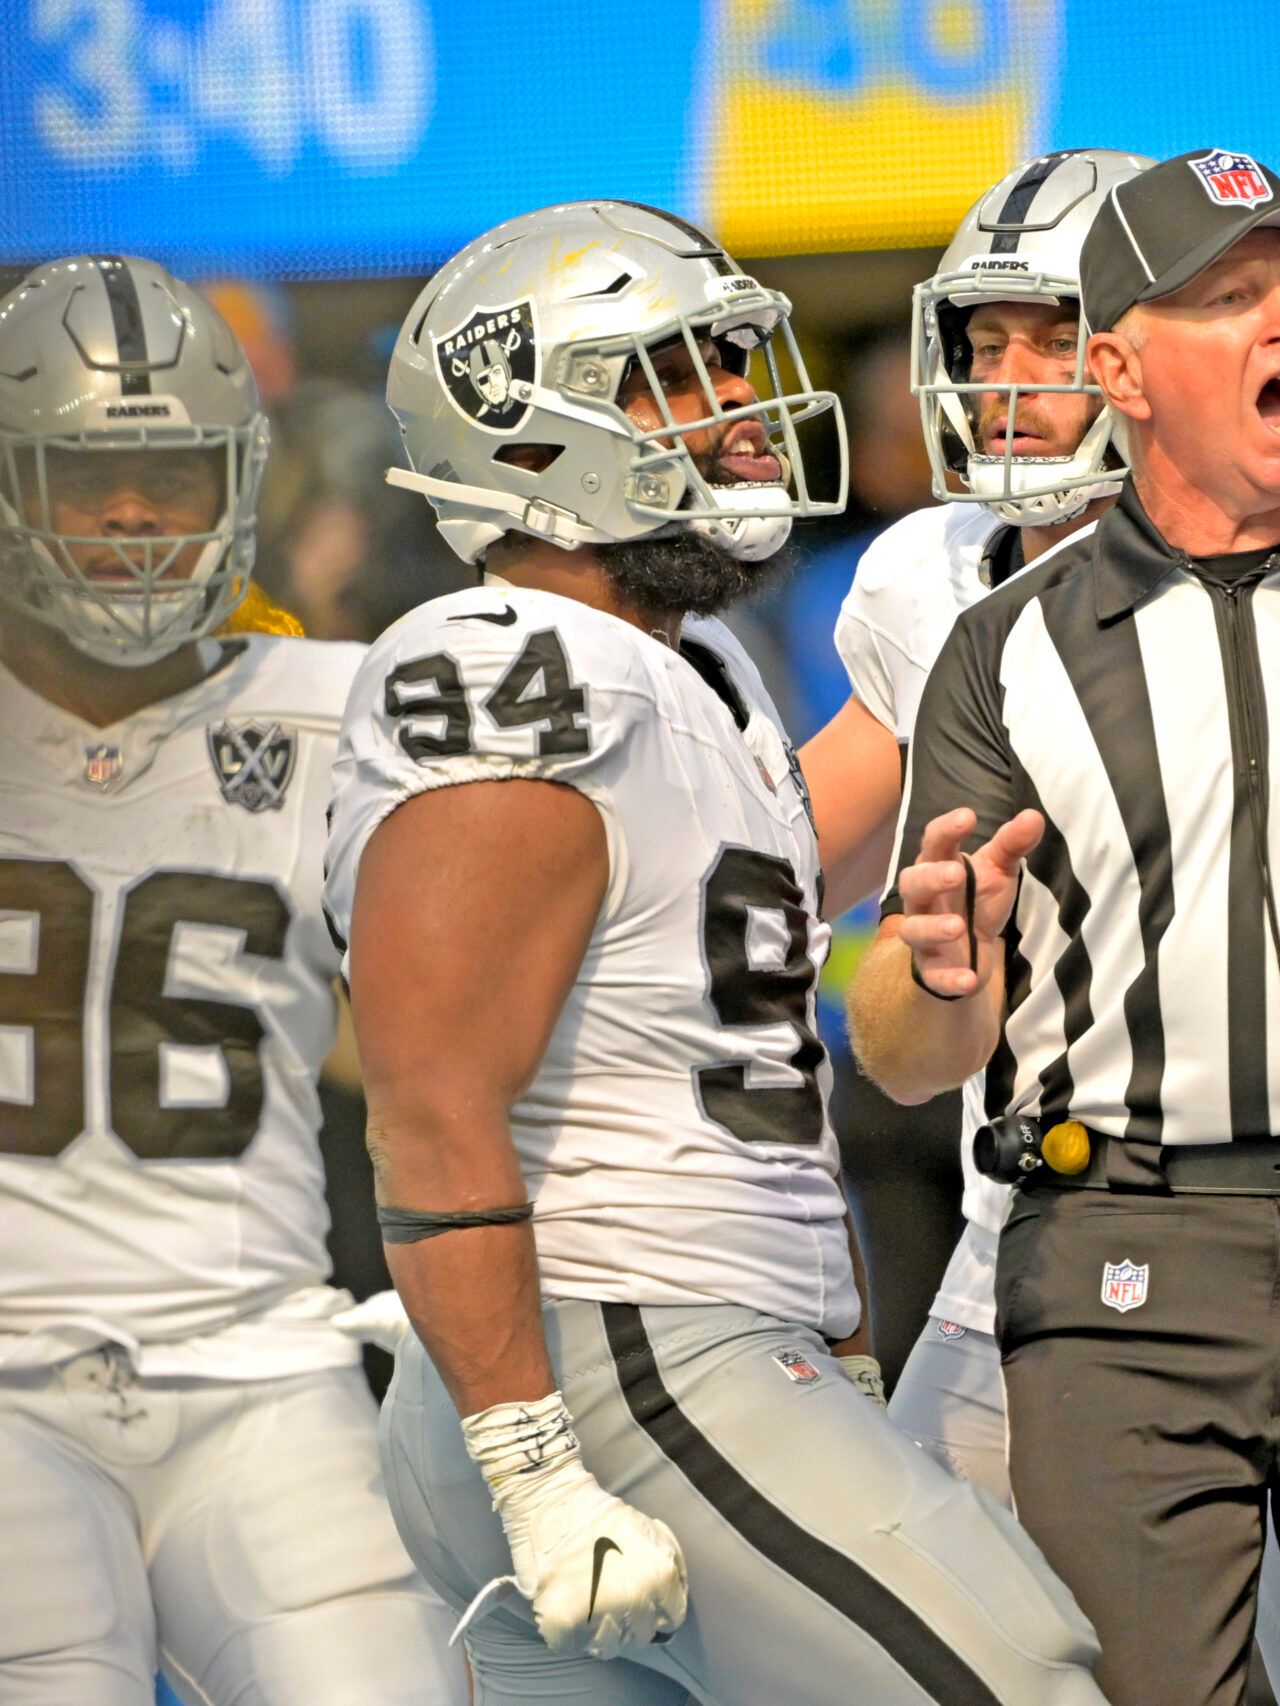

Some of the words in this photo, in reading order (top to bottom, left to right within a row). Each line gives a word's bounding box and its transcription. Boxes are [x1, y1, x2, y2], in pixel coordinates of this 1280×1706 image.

[1208, 170, 1266, 199] NFL
[971, 260, 1029, 271] RAIDERS
[444, 308, 521, 356] RAIDERS
[106, 406, 170, 417] RAIDERS
[383, 626, 593, 762] 94
[1020, 1124, 1034, 1143] OFF
[1108, 1282, 1141, 1303] NFL
